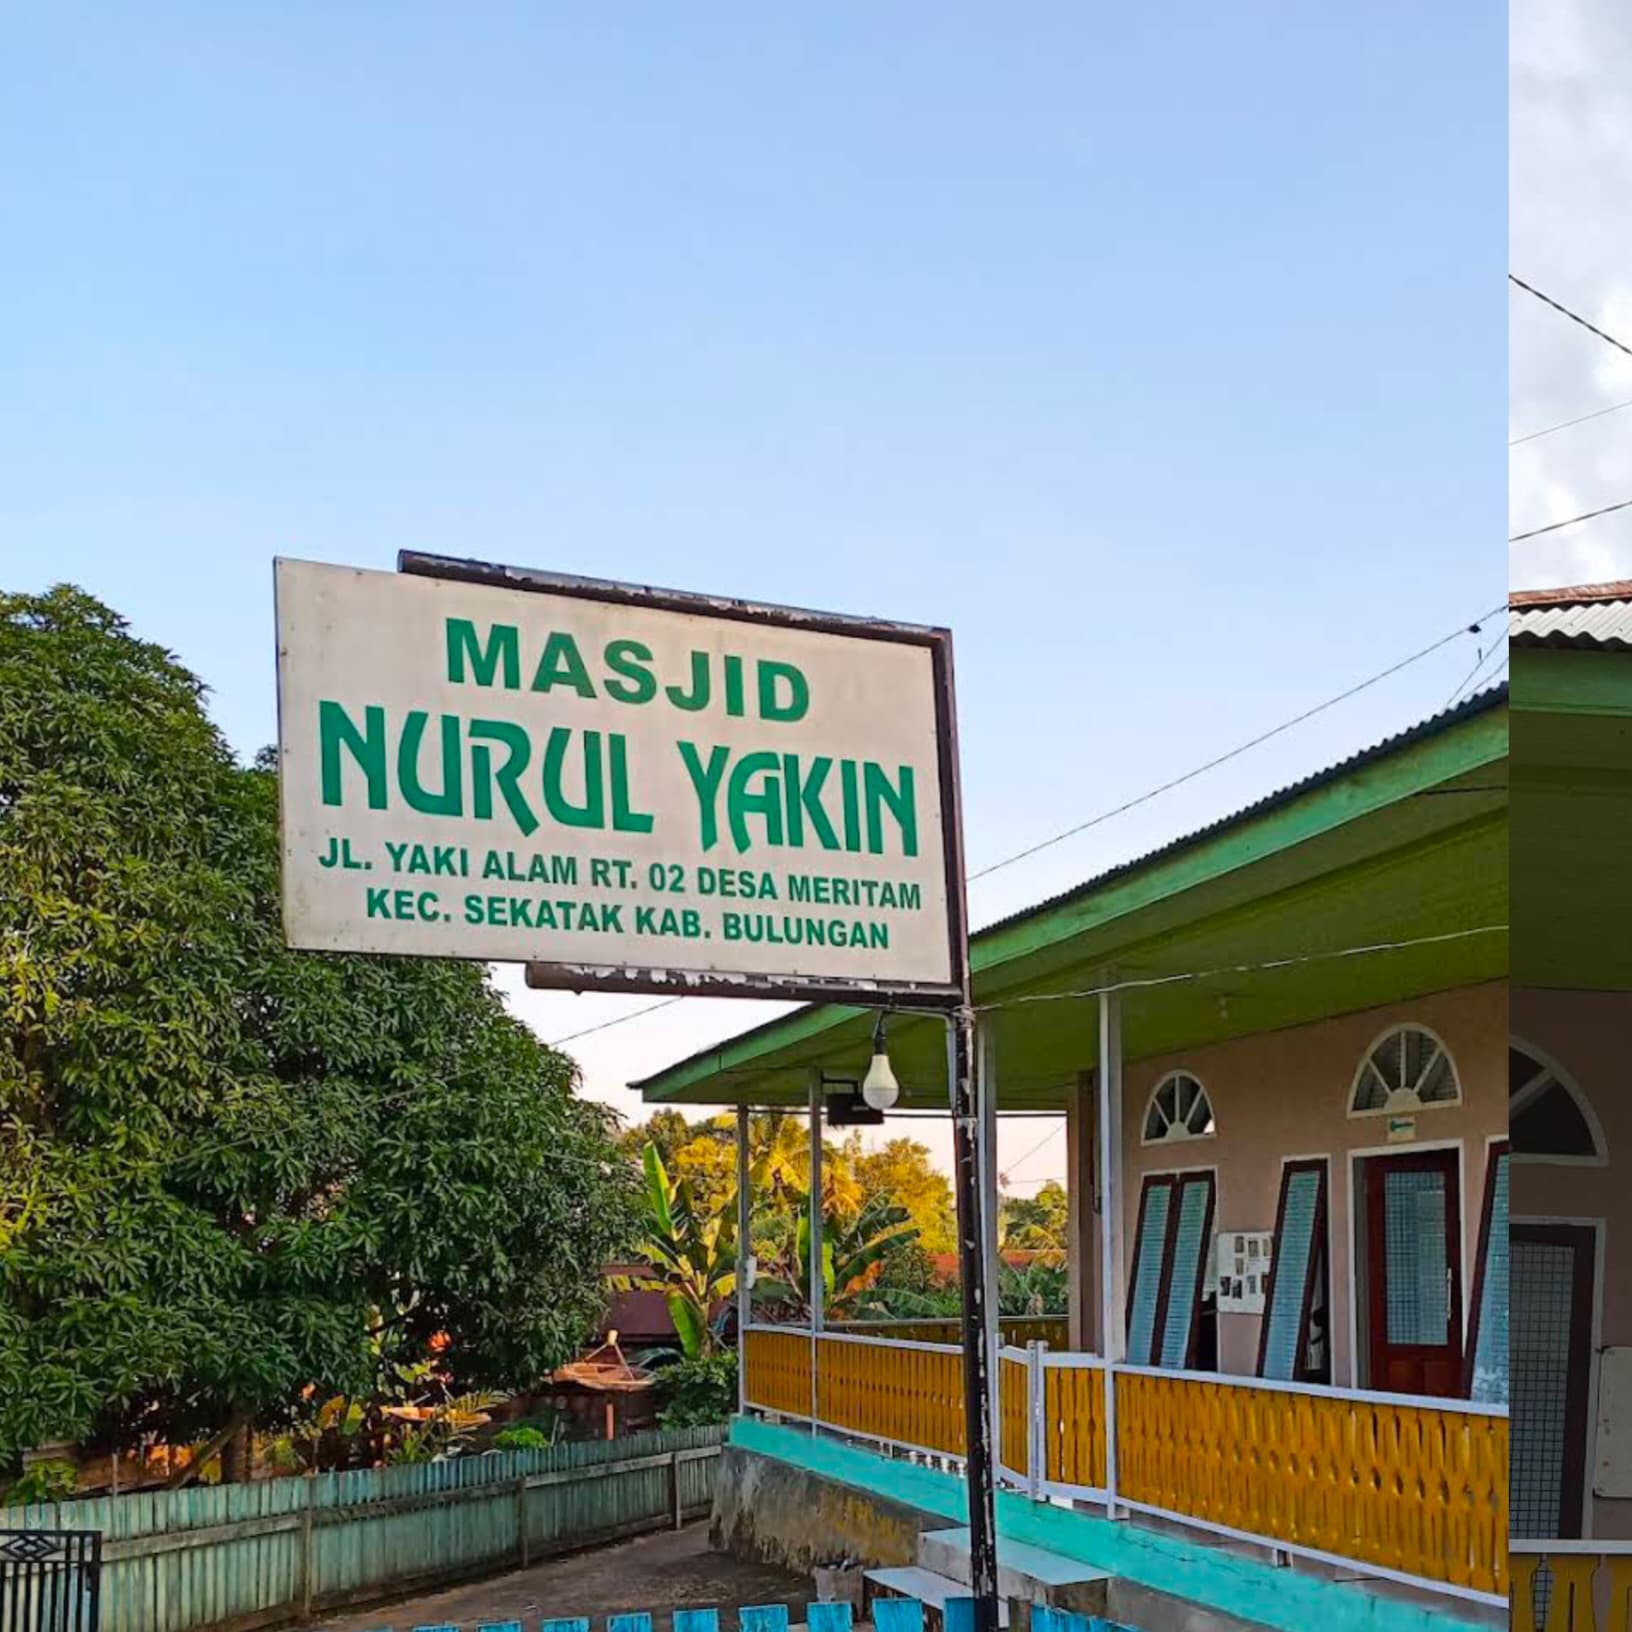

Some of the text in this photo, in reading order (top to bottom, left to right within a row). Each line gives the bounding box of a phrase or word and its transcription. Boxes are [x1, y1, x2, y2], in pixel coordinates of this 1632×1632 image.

[446, 618, 810, 722] MASJID
[318, 700, 918, 856] NURUL YAKIN
[319, 838, 921, 910] JL. YAKI ALAM RT. 02 DESA MERITAM
[367, 888, 889, 949] KEC. SEKATAK KAB. BULUNGAN
